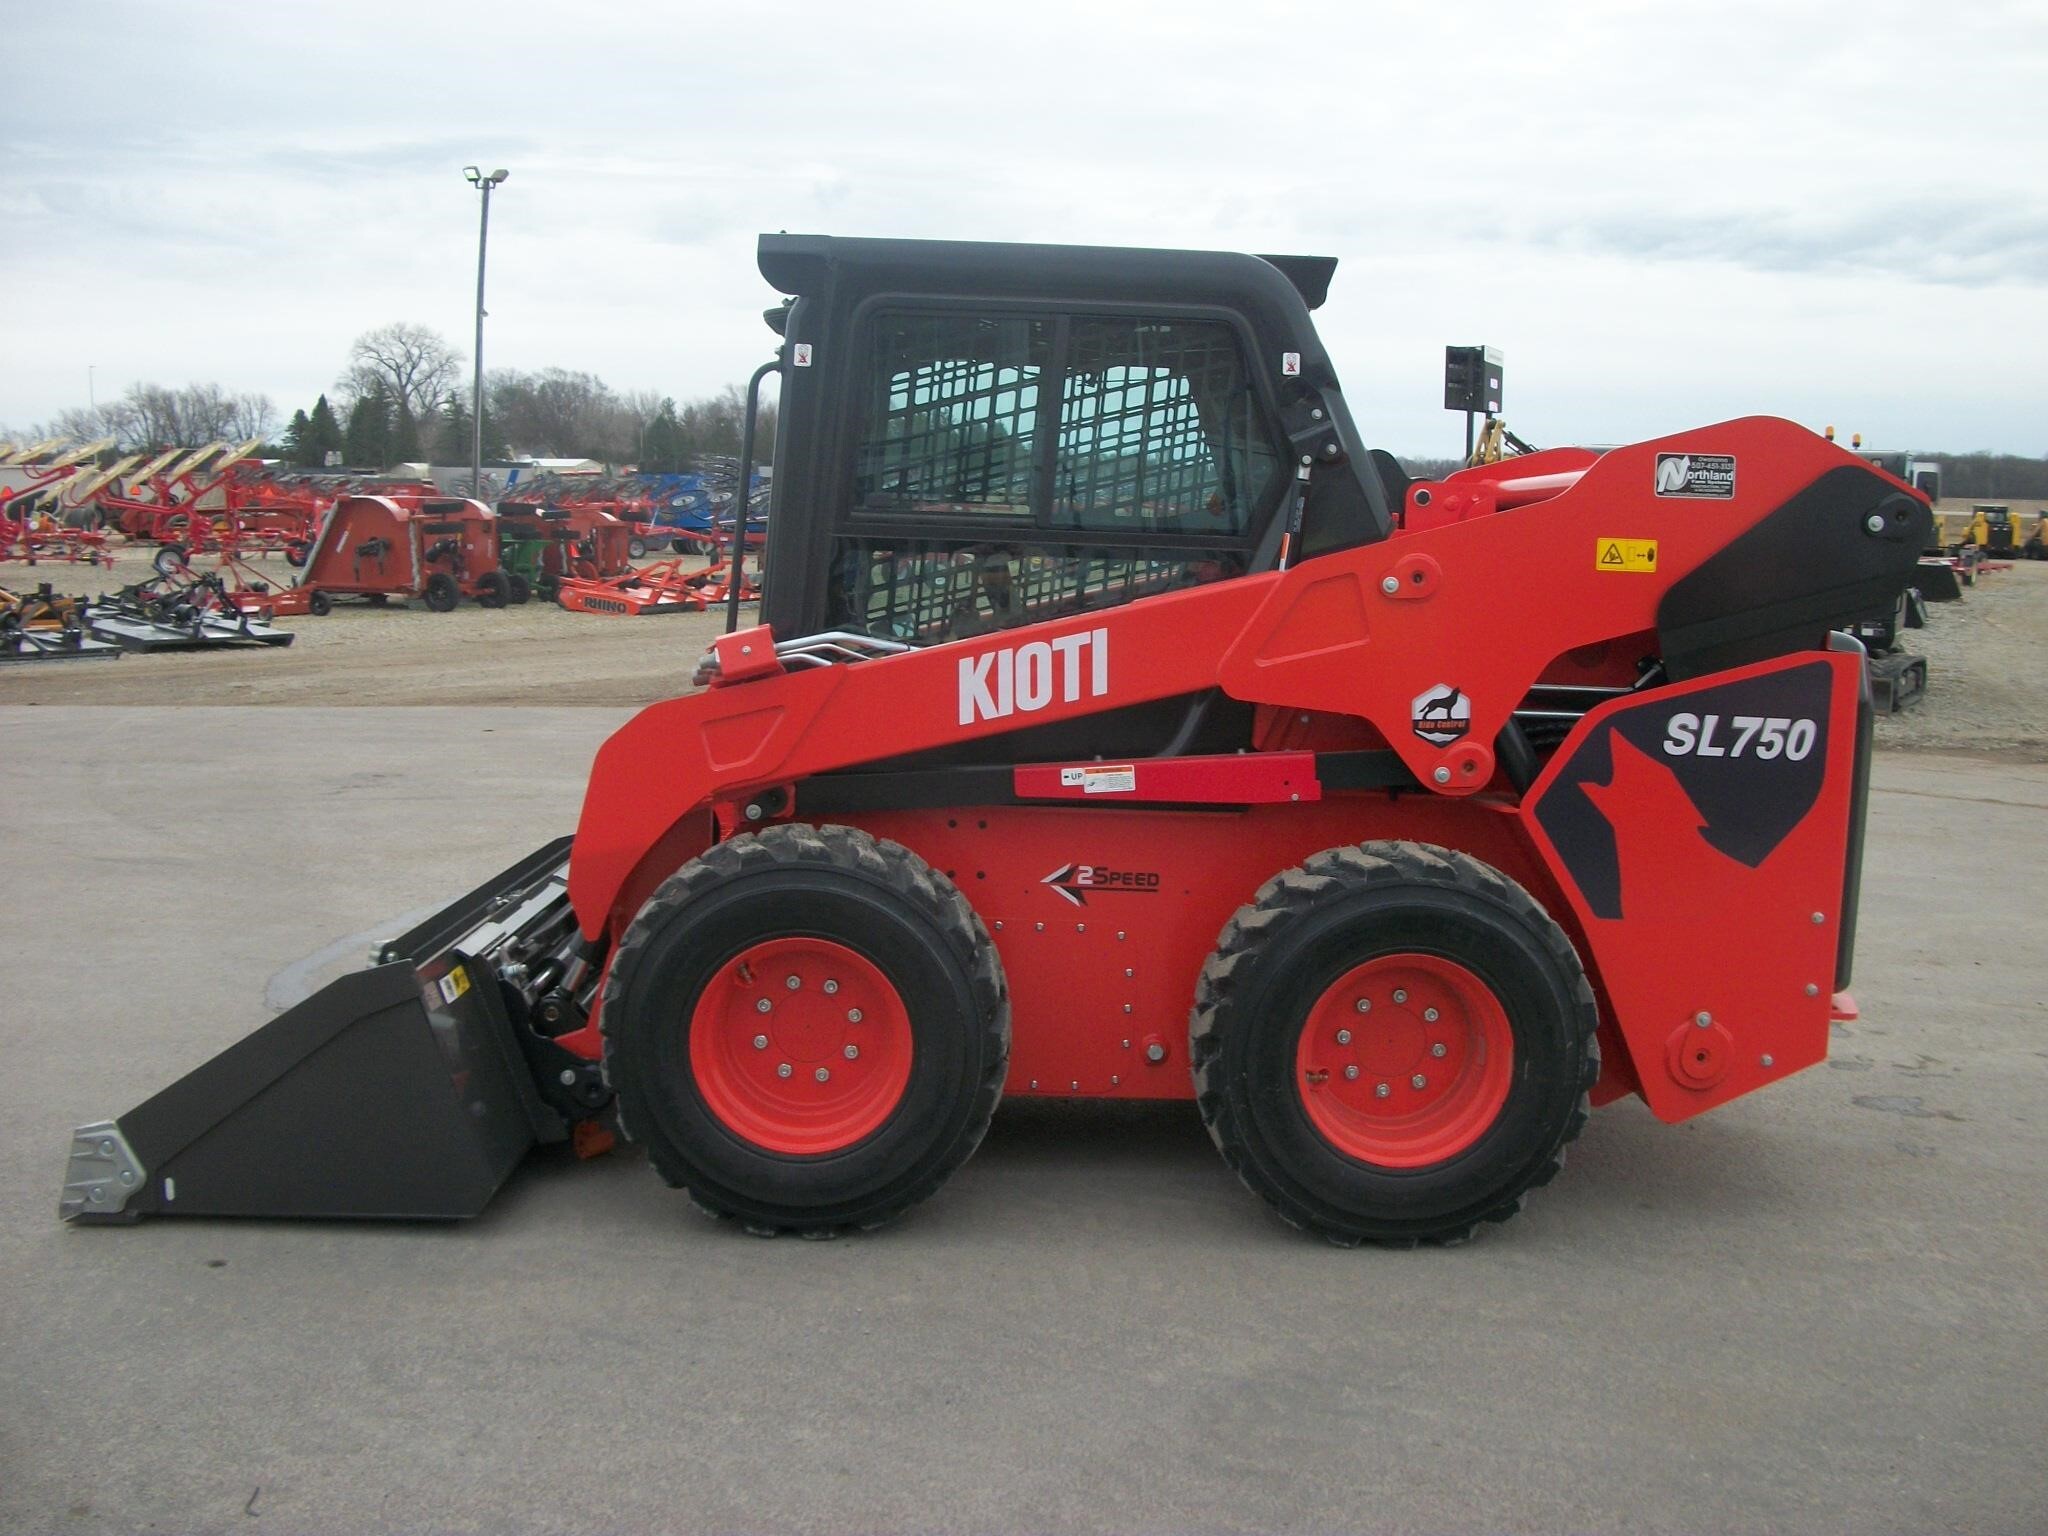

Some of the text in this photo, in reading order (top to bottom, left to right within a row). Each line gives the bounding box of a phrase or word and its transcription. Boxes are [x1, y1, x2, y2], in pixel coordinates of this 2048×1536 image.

[583, 597, 627, 614] RHINO
[958, 627, 1109, 726] KIOTI
[1662, 712, 1818, 762] SL750
[1071, 772, 1083, 781] UP
